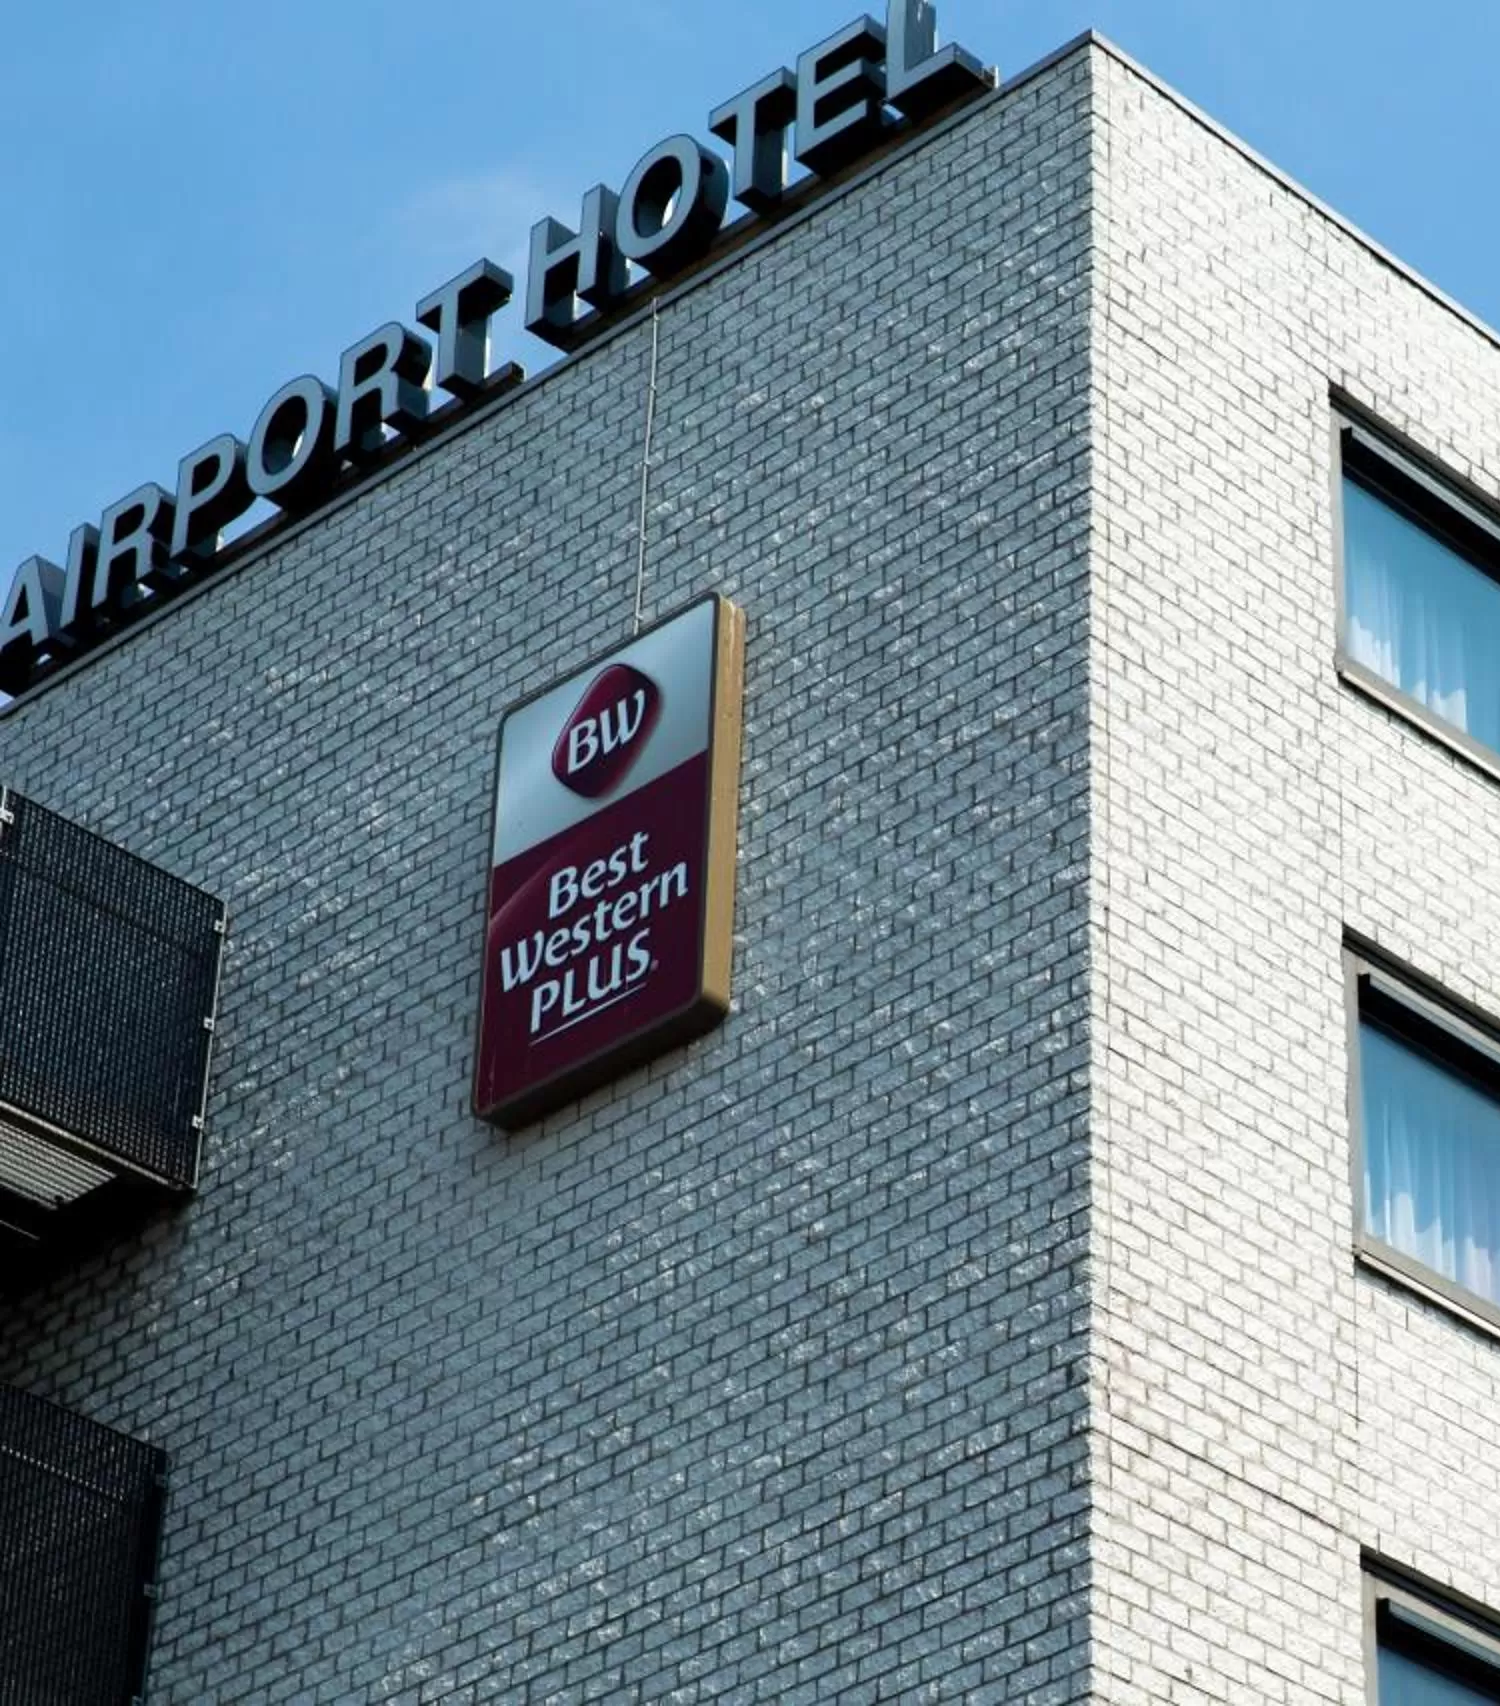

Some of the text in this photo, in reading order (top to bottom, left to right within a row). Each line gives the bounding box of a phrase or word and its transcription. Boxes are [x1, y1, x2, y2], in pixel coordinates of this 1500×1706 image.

[0, 0, 986, 675] AIRPORT HOTEL
[566, 689, 646, 777] BW
[500, 861, 689, 993] Western
[548, 831, 650, 919] Best
[529, 928, 653, 1034] PLUS
